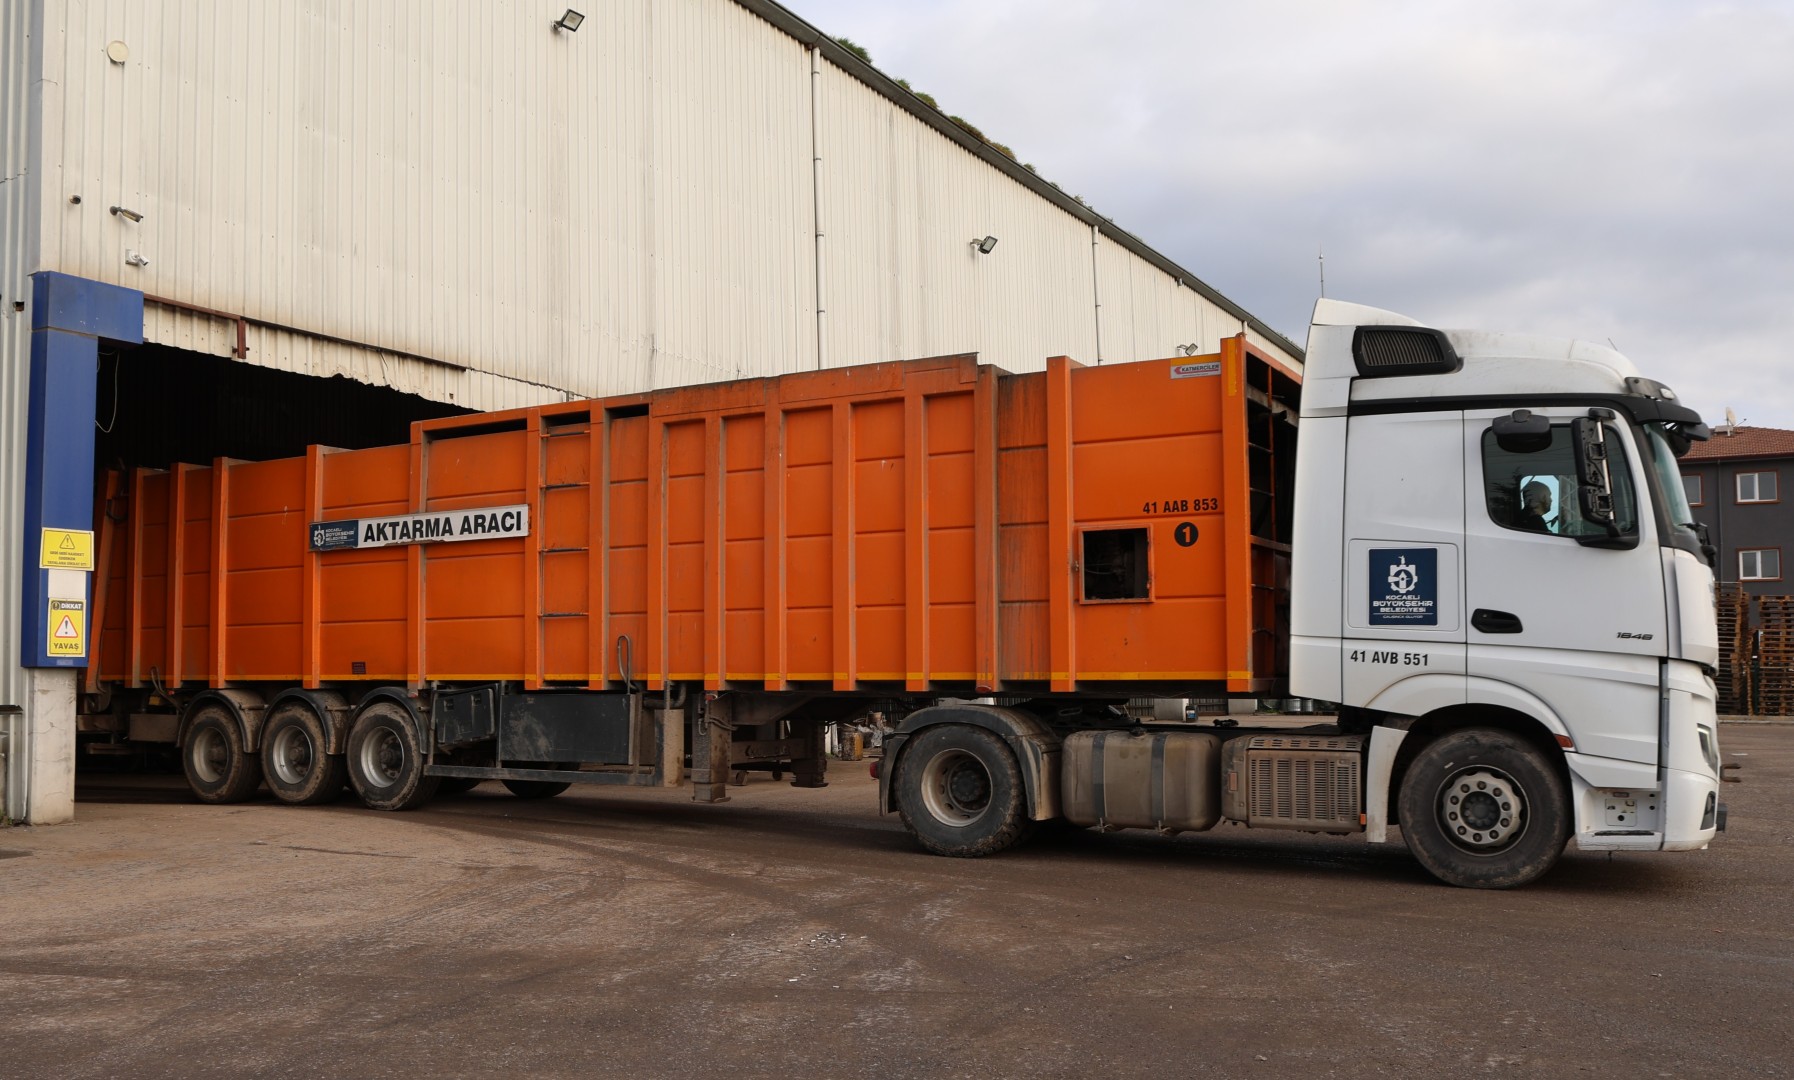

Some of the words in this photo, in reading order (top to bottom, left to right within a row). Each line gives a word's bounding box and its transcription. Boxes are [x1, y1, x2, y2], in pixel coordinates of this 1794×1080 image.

[1143, 502, 1157, 514] 41
[1163, 500, 1188, 513] AAB
[1193, 498, 1218, 512] 853
[363, 517, 453, 543] AKTARMA
[459, 511, 522, 536] ARACI
[53, 642, 80, 651] YAVAŞ
[1350, 650, 1366, 662] 41
[1372, 651, 1398, 664] AVB
[1404, 653, 1429, 666] 551
